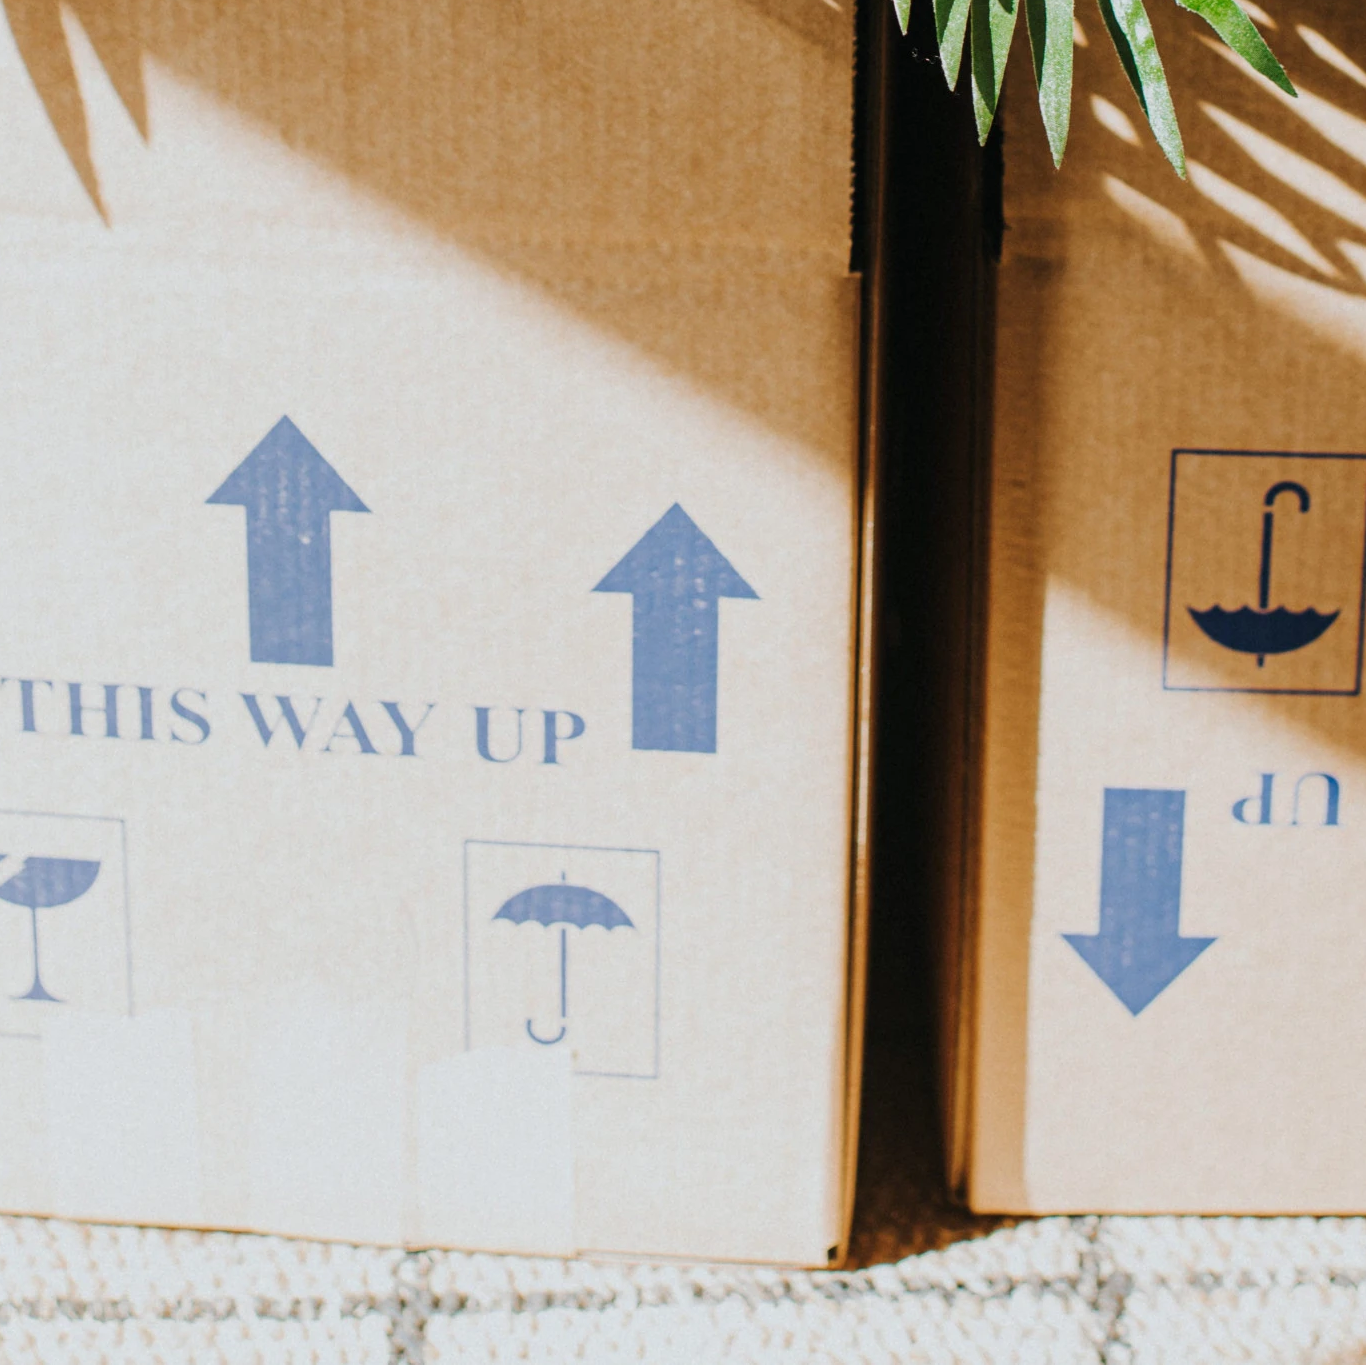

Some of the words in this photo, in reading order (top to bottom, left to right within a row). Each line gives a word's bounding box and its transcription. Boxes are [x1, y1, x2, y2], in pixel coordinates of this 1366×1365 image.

[0, 676, 212, 745] THIS
[237, 692, 434, 757] WAY
[473, 705, 586, 764] UP
[1231, 771, 1341, 827] UP
